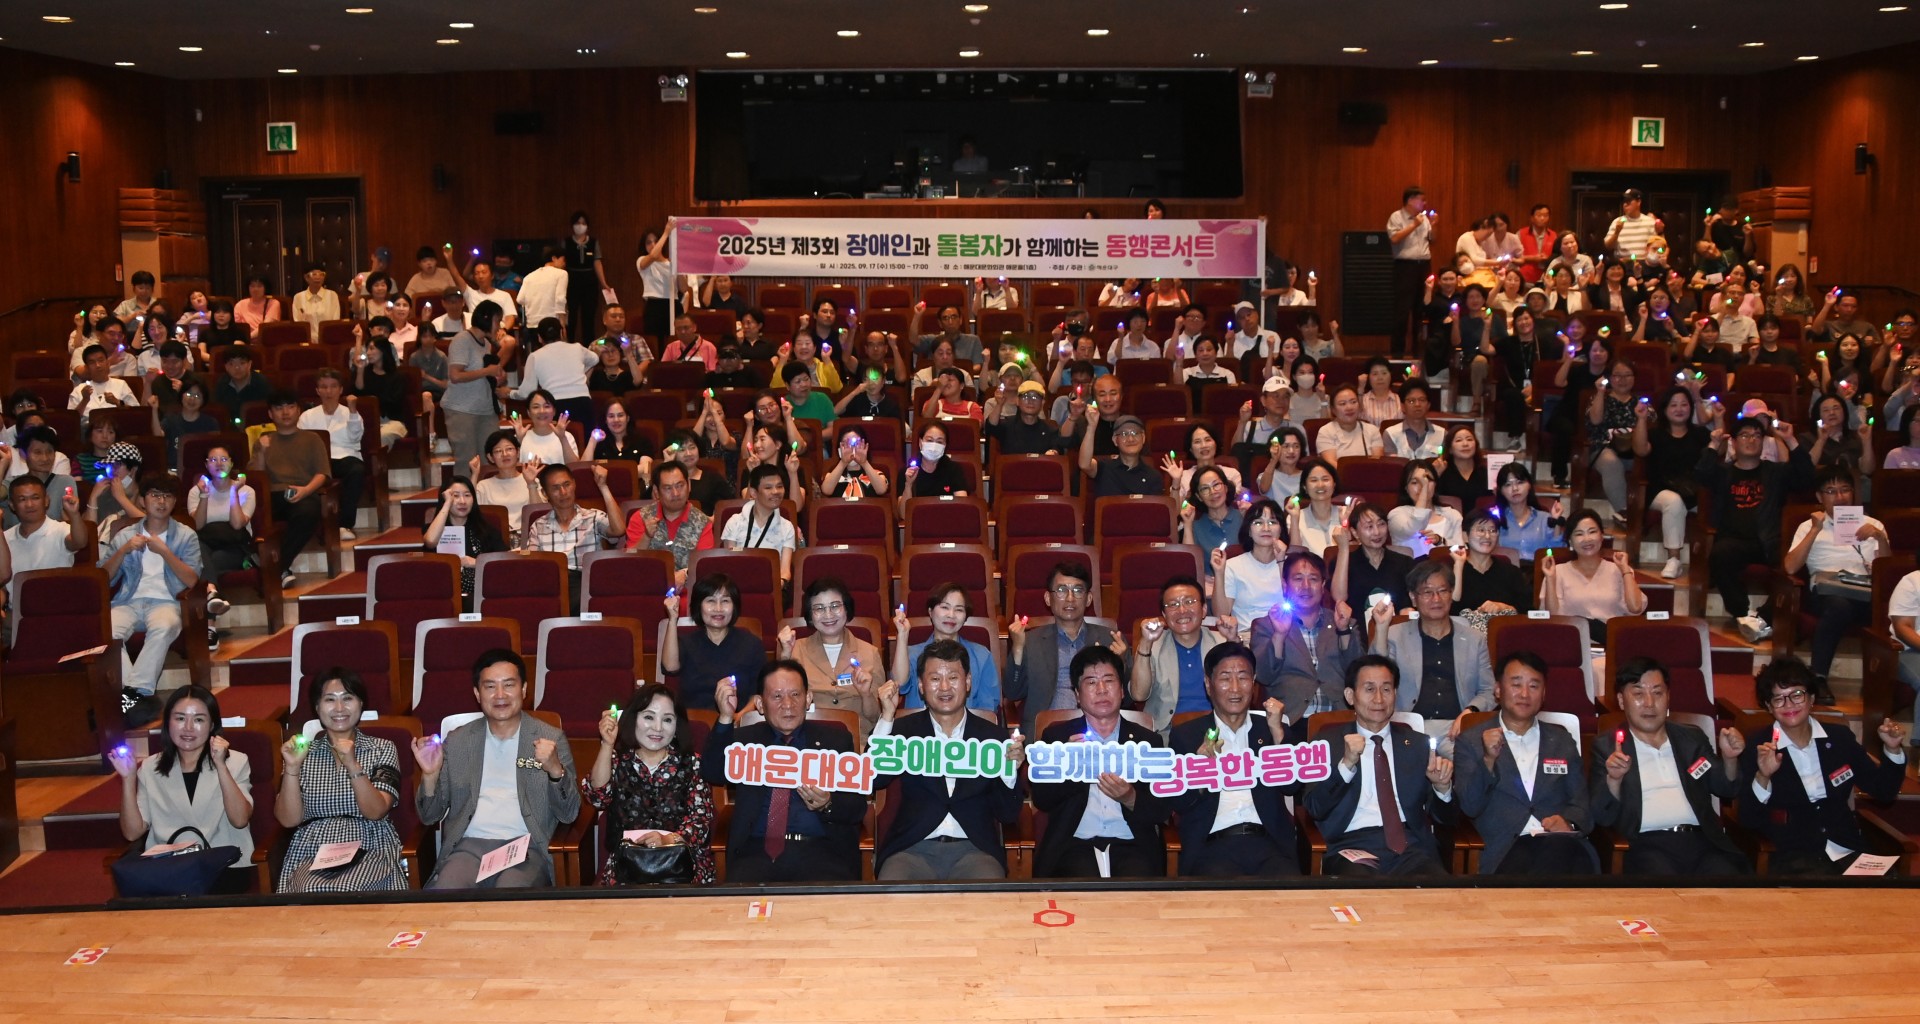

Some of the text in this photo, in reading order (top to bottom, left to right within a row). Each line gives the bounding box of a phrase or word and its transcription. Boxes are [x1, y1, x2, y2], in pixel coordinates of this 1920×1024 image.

[719, 233, 1216, 259] 2025년 제3회 장애인과 돌봄자가 함께하는 동행콘서트
[728, 745, 875, 791] 해운대와
[870, 737, 1014, 777] 장애인이
[1028, 744, 1174, 780] 함께하는
[1261, 743, 1328, 783] 동행
[390, 932, 425, 948] 2
[1622, 920, 1656, 936] 2
[69, 948, 104, 965] 3
